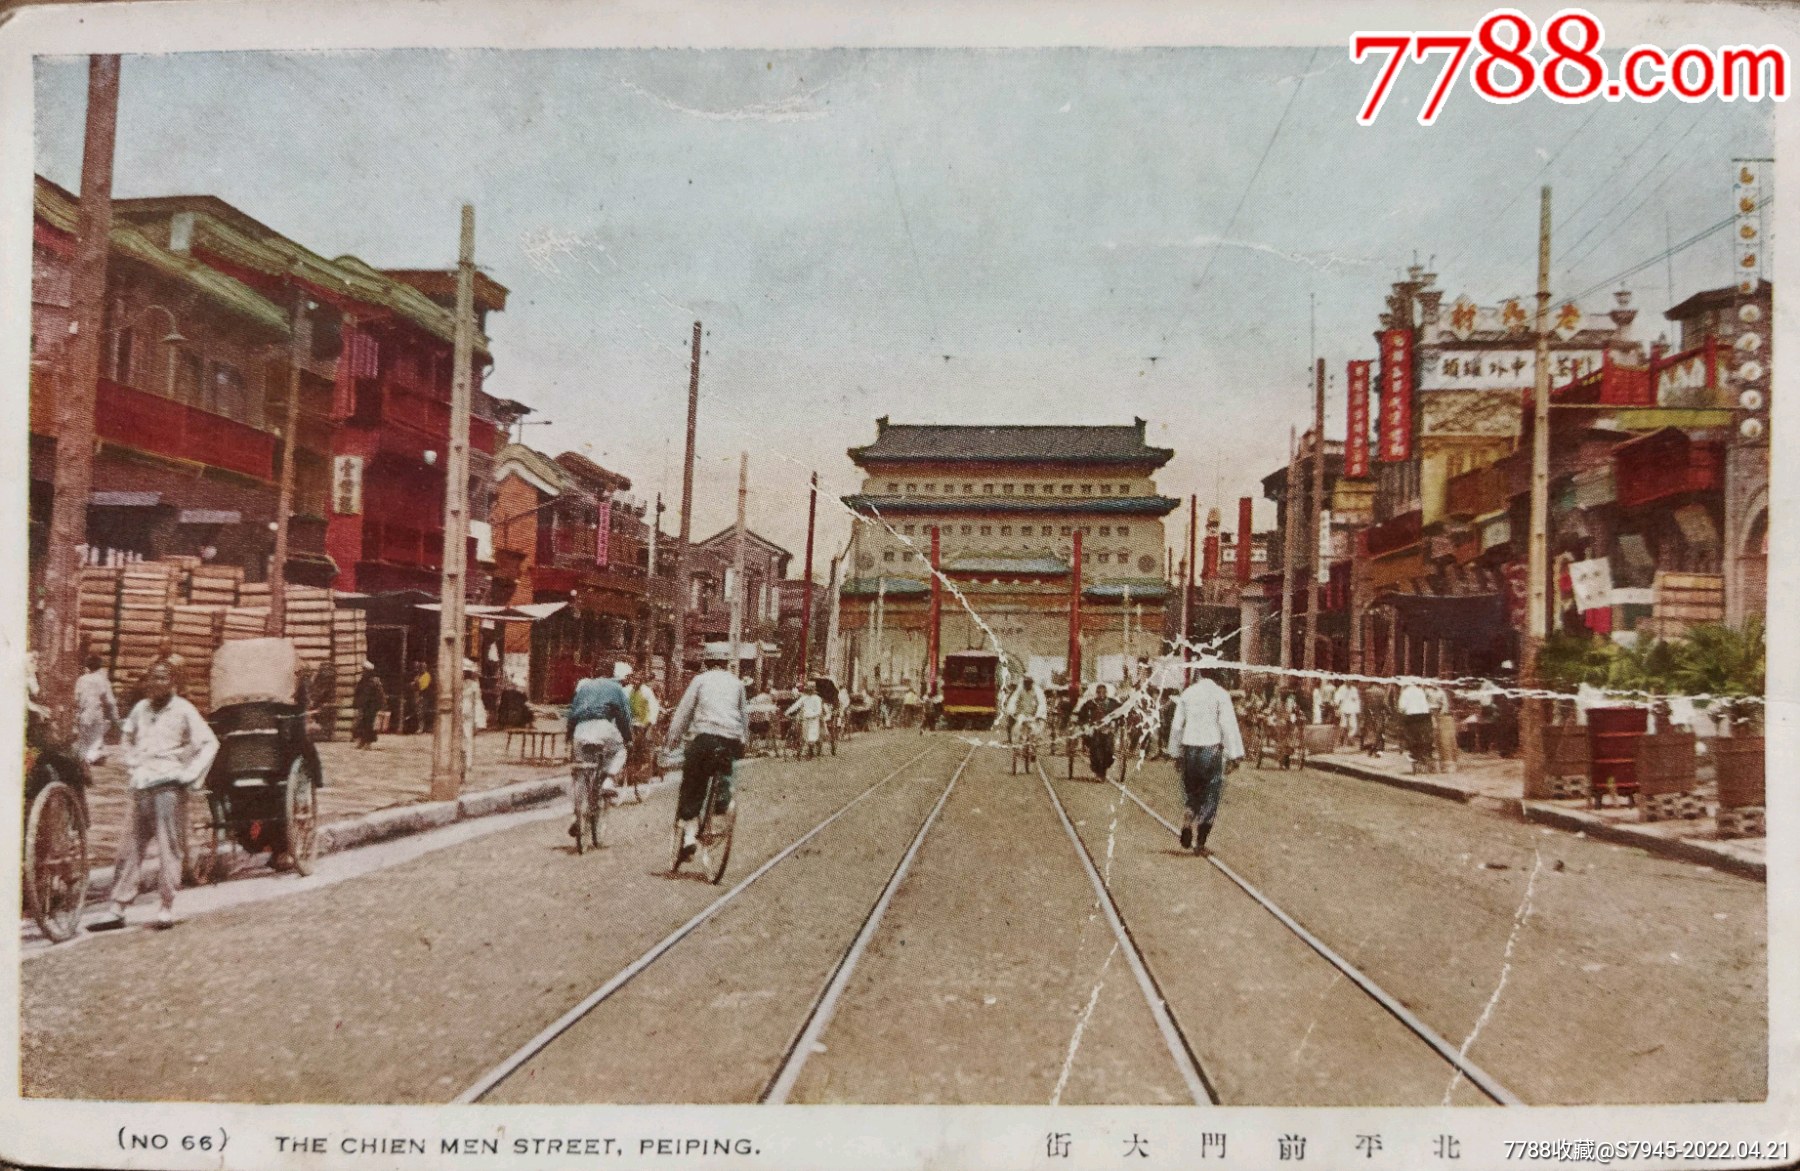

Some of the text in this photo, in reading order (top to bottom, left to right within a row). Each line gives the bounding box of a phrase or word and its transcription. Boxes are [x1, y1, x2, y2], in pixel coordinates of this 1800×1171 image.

[117, 1126, 230, 1152] (NO 66)
[274, 1135, 761, 1157] THE CHIEN MEN STREET, PEIPING.
